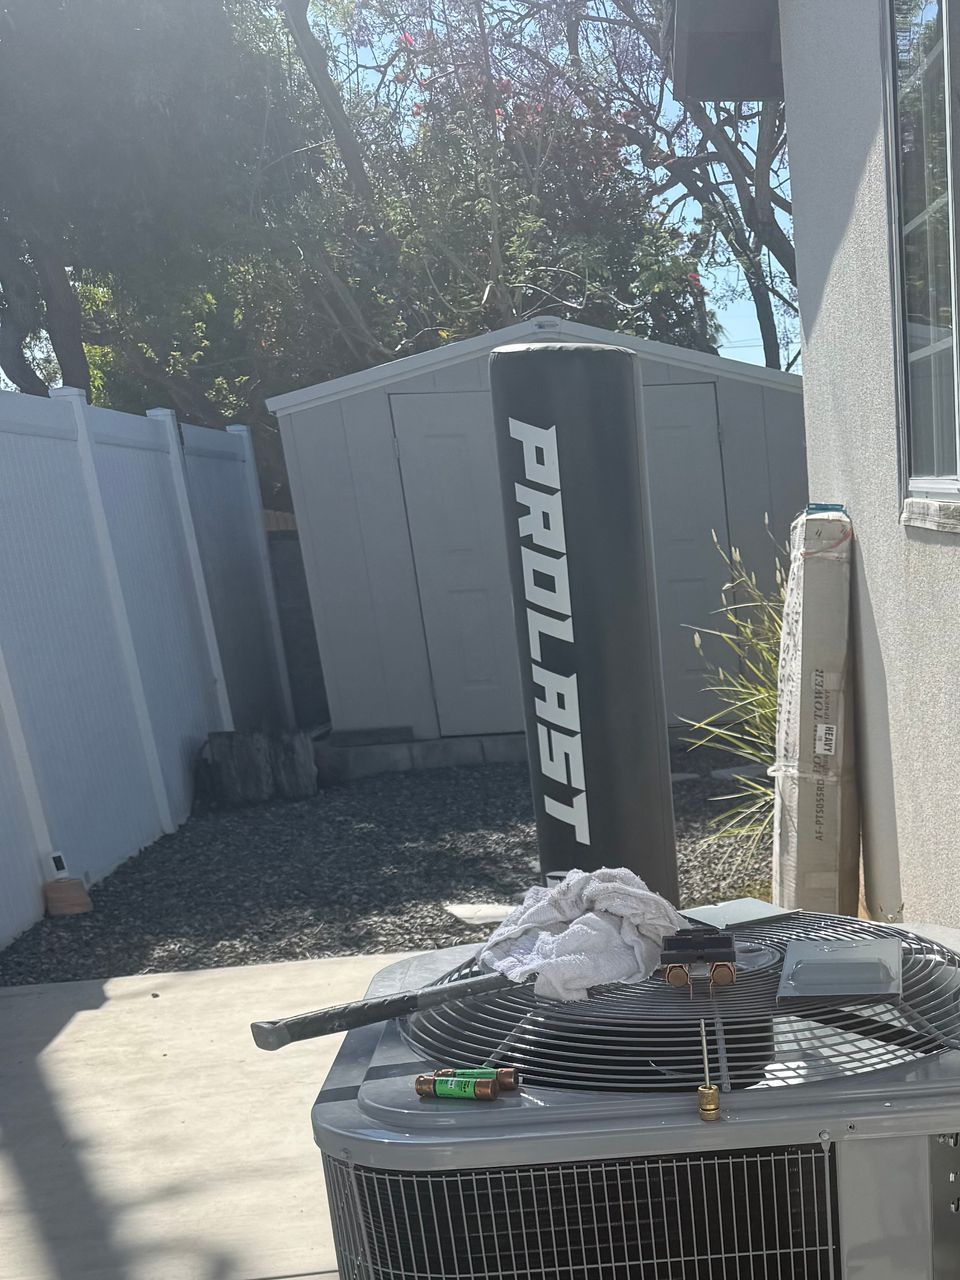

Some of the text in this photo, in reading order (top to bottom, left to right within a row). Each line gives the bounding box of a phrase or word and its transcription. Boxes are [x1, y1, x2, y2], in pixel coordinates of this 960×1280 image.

[508, 416, 591, 846] PROLAST
[813, 668, 825, 721] TOWER
[824, 726, 834, 754] HEAVY
